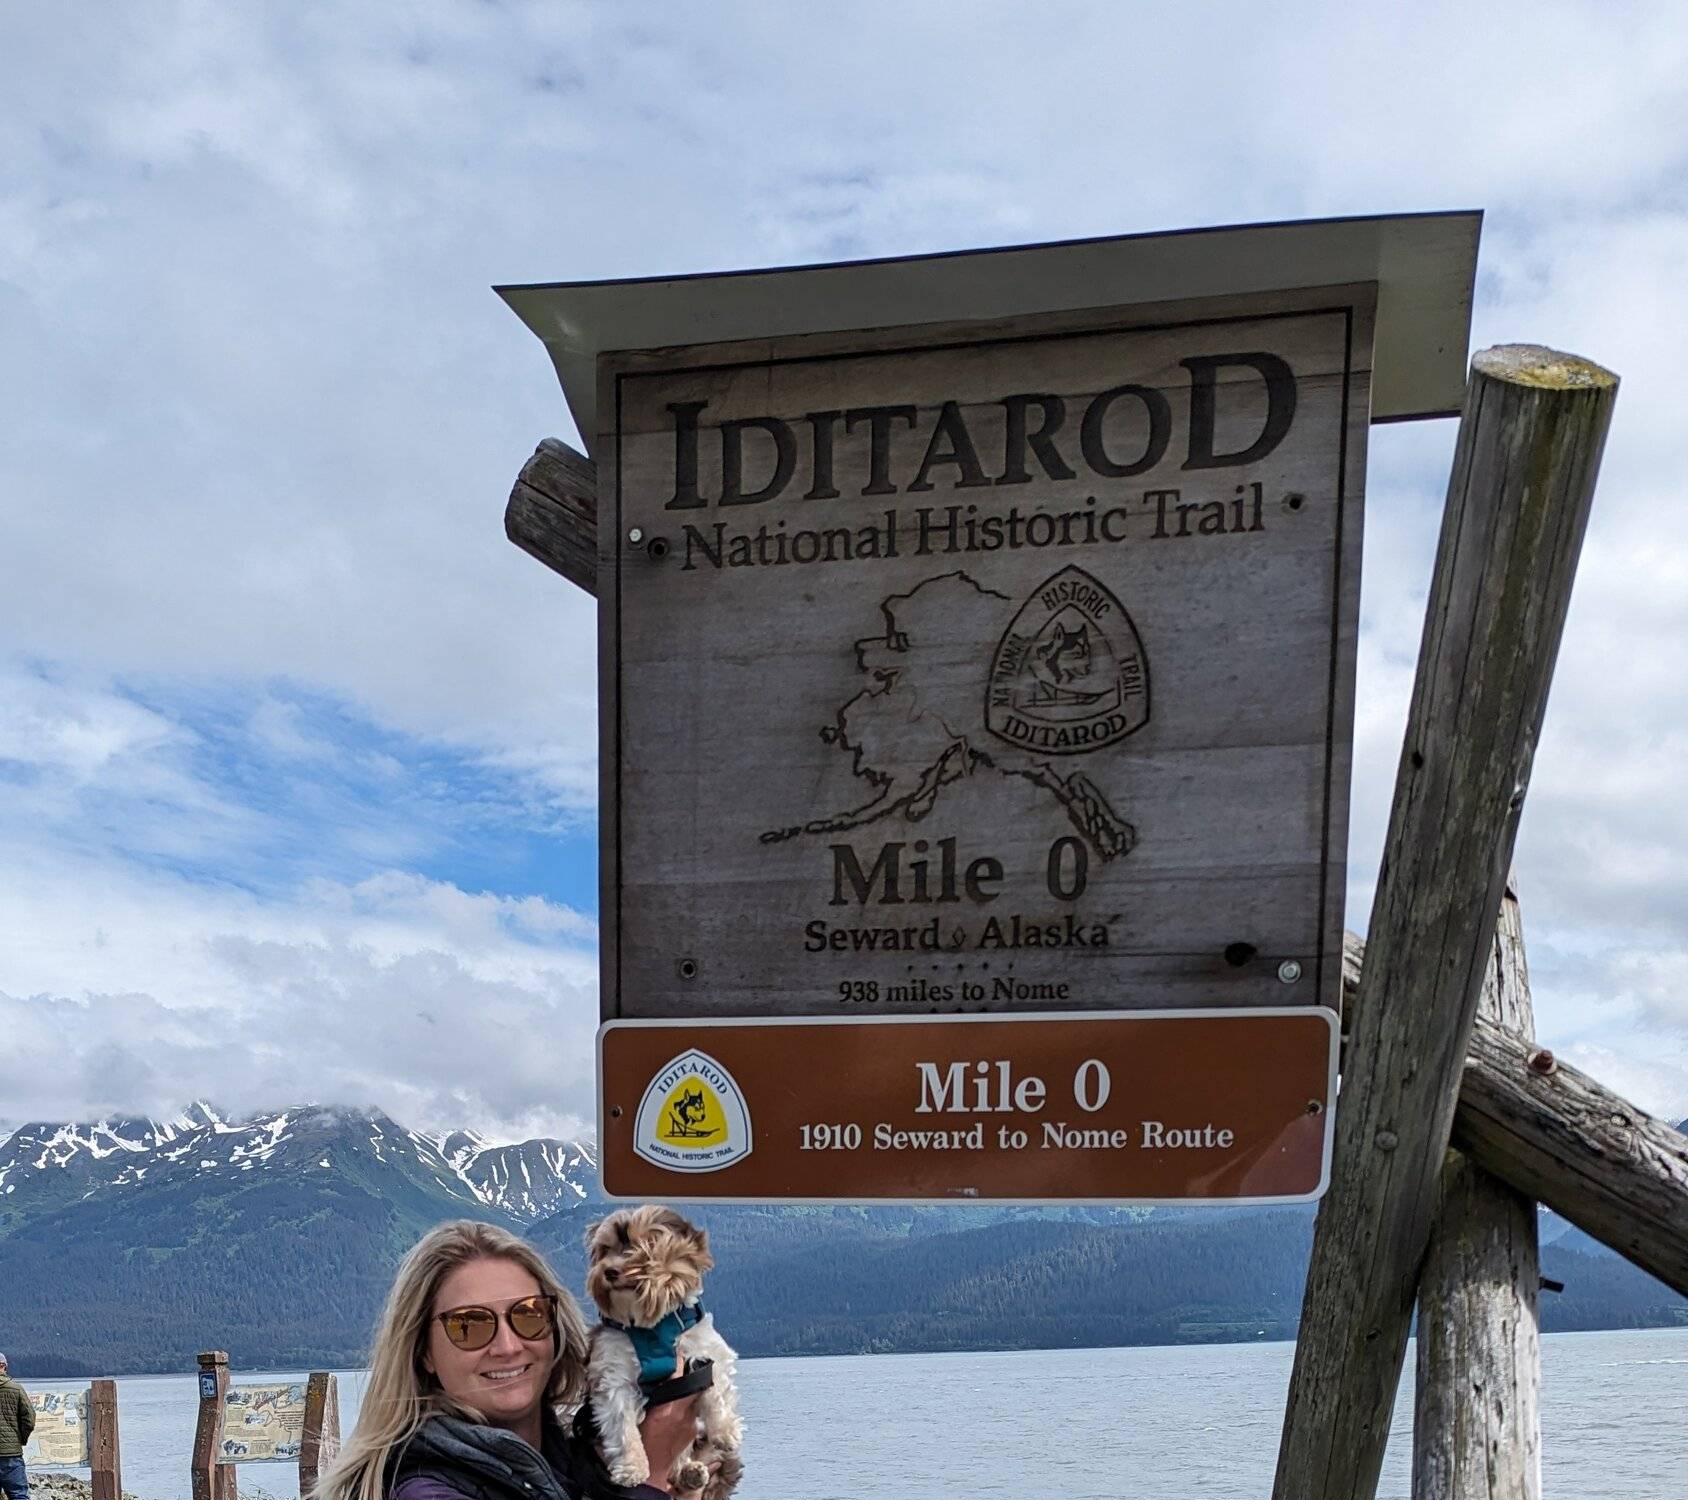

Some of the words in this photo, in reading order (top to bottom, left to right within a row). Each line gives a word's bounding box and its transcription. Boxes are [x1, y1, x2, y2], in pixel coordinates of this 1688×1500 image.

[664, 352, 1297, 510] IDITAROD
[681, 510, 899, 570] National
[914, 496, 1127, 555] Historic
[1143, 482, 1265, 539] Trail
[1041, 581, 1111, 619] HISTORIC
[1119, 653, 1143, 701] TRAIL
[1002, 713, 1127, 747] IDITAROD
[828, 836, 1004, 906] Mile
[1047, 836, 1089, 901] 0
[804, 917, 940, 952] Seward
[979, 914, 1110, 950] Alaska
[839, 980, 879, 1002] 938
[886, 979, 953, 1001] miles
[961, 981, 985, 1001] to
[992, 977, 1069, 1001] Nome
[657, 1062, 728, 1094] IDITAROD
[915, 1060, 1046, 1113] Mile
[1073, 1059, 1111, 1112] 0
[649, 1143, 680, 1160] NATIONAL
[682, 1151, 714, 1161] HISTORIC
[715, 1146, 735, 1158] TRAIL
[800, 1123, 862, 1150] 1910
[874, 1123, 984, 1150] Seward
[998, 1125, 1028, 1149] to
[1041, 1122, 1128, 1149] Nome
[1141, 1121, 1234, 1149] Route
